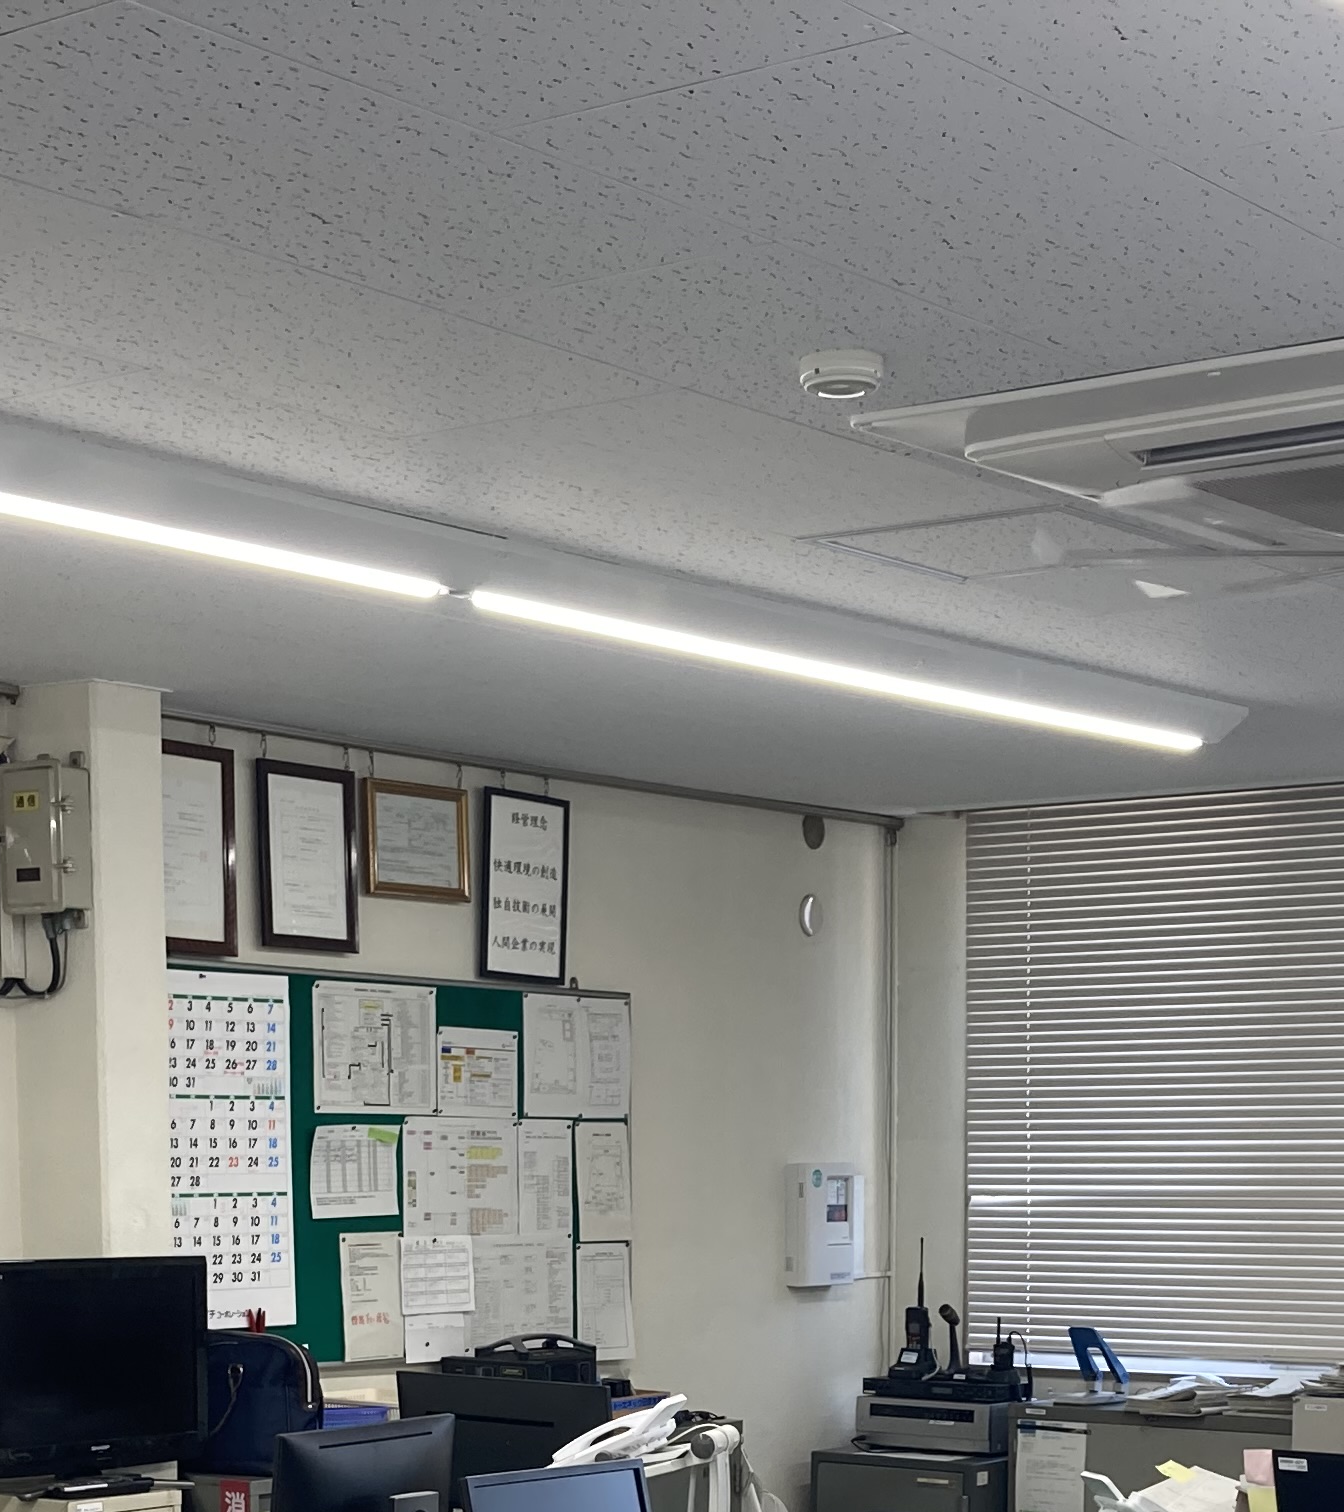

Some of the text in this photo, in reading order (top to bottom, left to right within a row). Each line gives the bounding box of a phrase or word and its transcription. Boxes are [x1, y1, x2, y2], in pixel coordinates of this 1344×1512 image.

[168, 1000, 273, 1014] 2 3 4 5 6 7
[168, 1019, 275, 1033] 9 10 11 12 13 14
[187, 1039, 275, 1052] 17 18 19 20 21
[186, 1077, 195, 1087] 31
[210, 1101, 274, 1111] 1 2 3 4
[170, 1138, 277, 1148] 13 14 15 16 17 18
[171, 1157, 278, 1167] 20 21 22 23 24 25
[171, 1176, 200, 1187] 27 28
[214, 1198, 276, 1209] 1 2 3 4
[174, 1216, 277, 1228] 6 7 8 9 10 11
[213, 1252, 281, 1265] 22 23 24 25
[213, 1271, 260, 1283] 29 30 31
